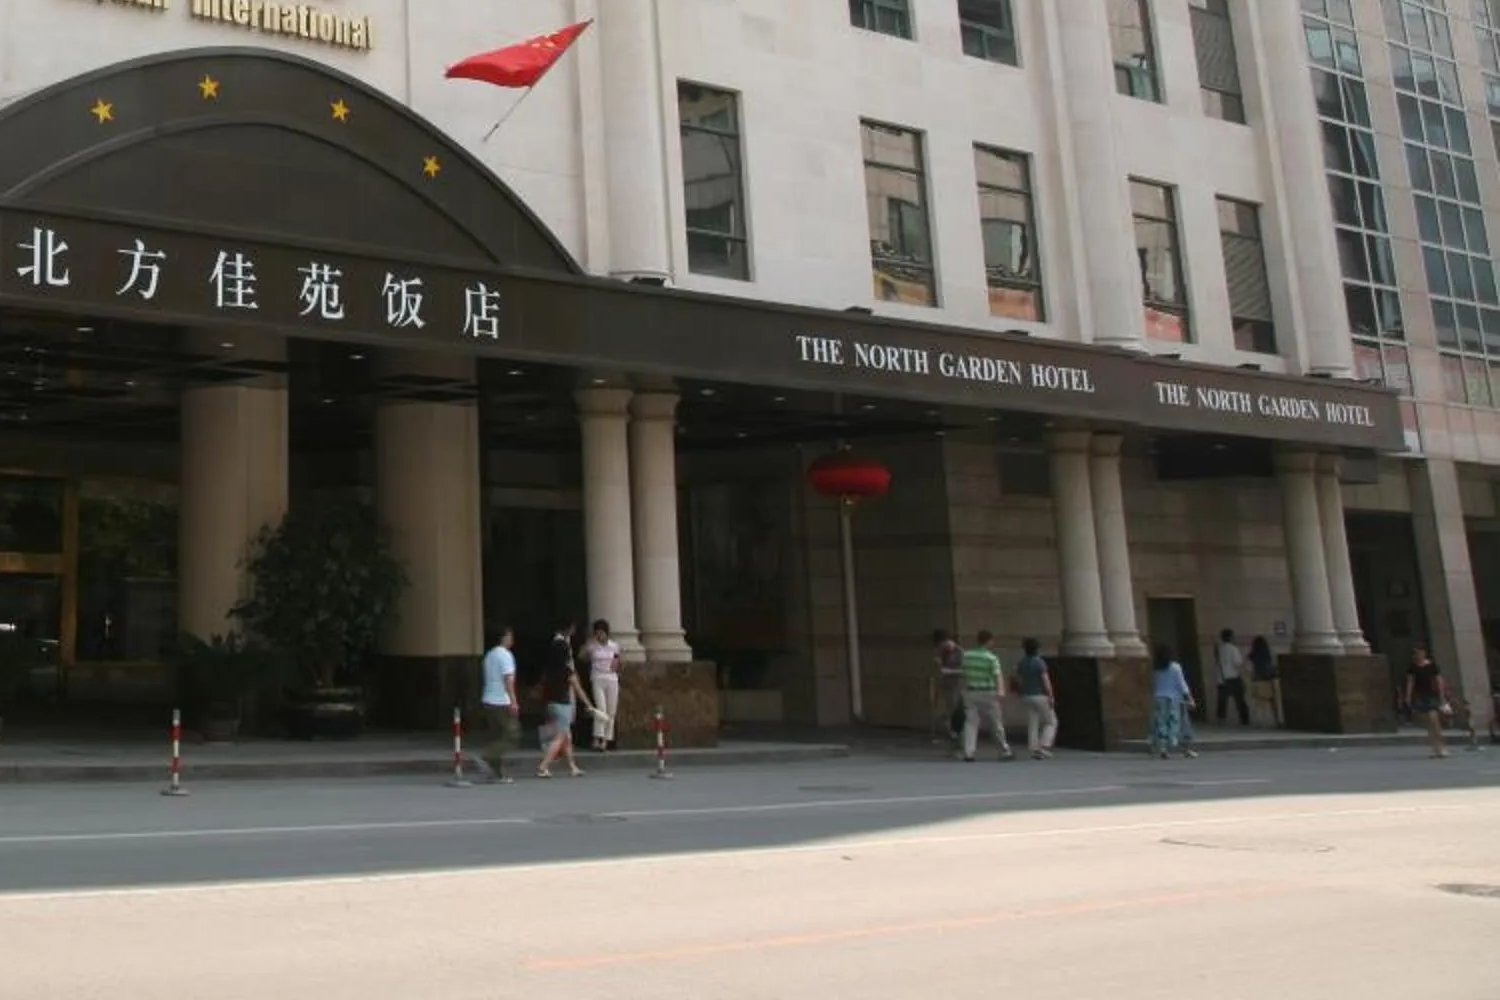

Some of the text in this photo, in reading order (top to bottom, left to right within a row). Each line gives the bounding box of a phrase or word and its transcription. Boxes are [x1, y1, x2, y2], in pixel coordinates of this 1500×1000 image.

[16, 226, 501, 340] 北方佳苑饭店
[795, 334, 1096, 394] THE NORTH GARDEN HOTEL
[1154, 380, 1376, 428] THE NORTH GARDEN HOTEL
